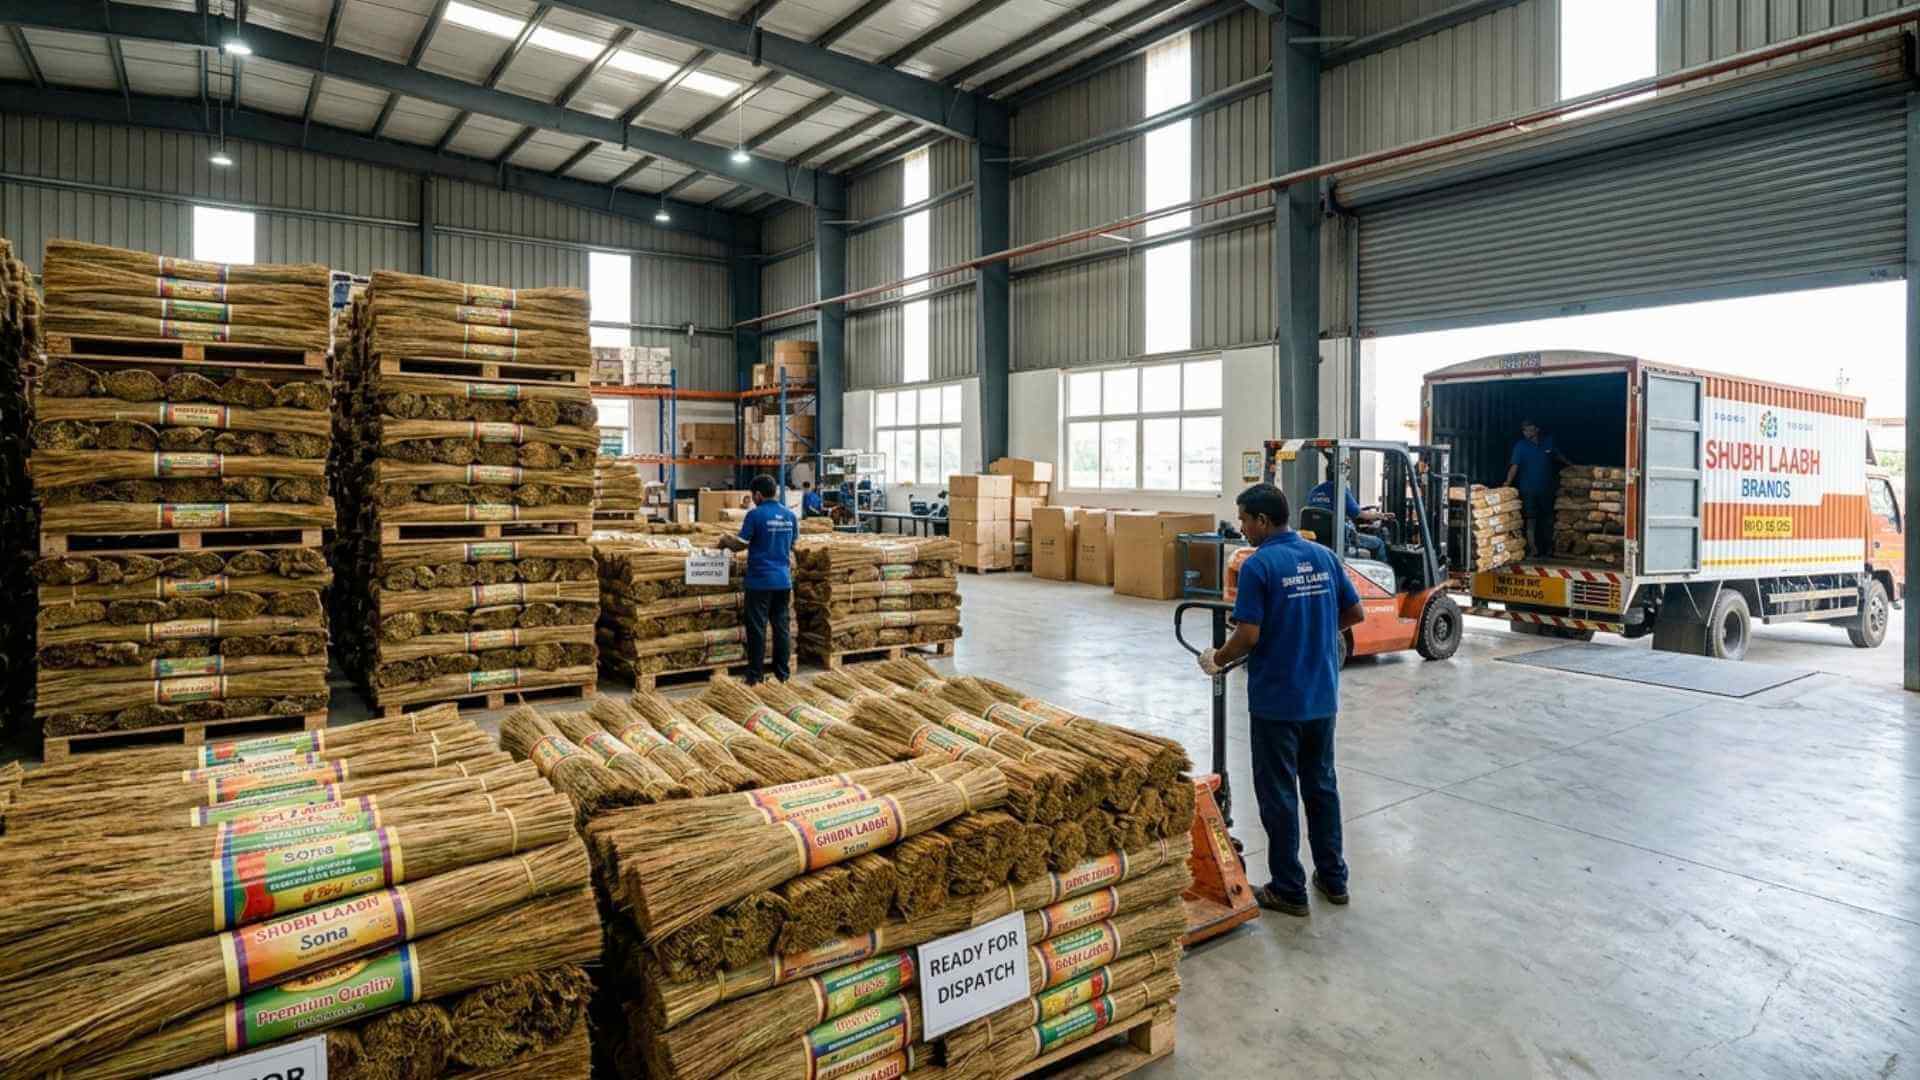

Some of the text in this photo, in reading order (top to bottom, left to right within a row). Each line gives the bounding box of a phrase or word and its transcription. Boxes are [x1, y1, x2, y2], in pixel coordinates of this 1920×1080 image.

[1706, 440, 1820, 475] SHUBH LAABH
[300, 926, 348, 951] Sona
[930, 930, 1018, 977] READY FOR
[338, 976, 395, 1001] Quality
[938, 960, 1015, 1004] DISPATCH
